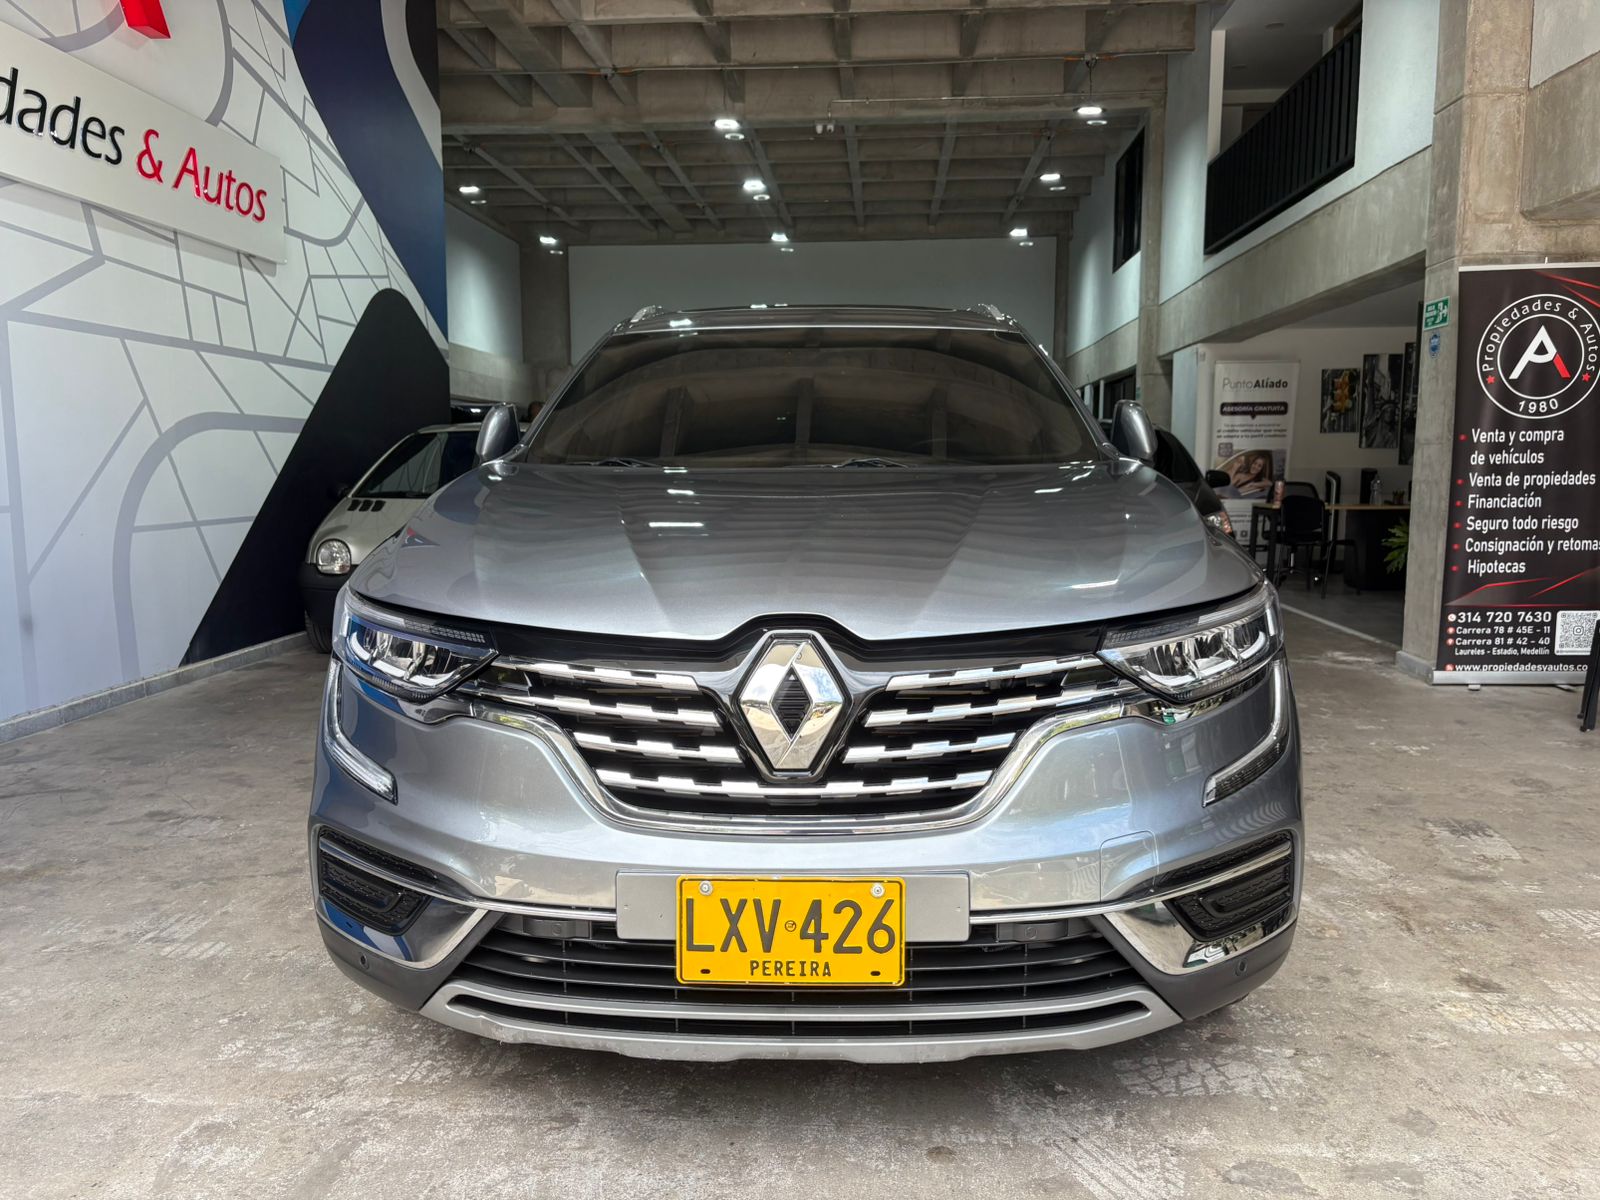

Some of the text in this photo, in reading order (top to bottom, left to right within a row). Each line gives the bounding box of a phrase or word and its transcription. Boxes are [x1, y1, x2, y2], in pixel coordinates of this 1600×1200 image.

[136, 128, 163, 183] &
[172, 147, 268, 222] Autos
[1482, 299, 1599, 372] Propiedades & Autos
[1518, 398, 1559, 414] 1980
[1472, 428, 1564, 446] Venta y compra
[1470, 448, 1544, 465] de vehículos
[1469, 470, 1596, 489] Venta de propiedades
[1467, 492, 1541, 508] Financiación
[1466, 515, 1579, 533] Seguro todo riesgo
[1465, 536, 1600, 555] Consignación y retoma
[1467, 559, 1526, 577] Hipotecas
[1457, 611, 1552, 623] 314 720 7630
[1456, 626, 1491, 634] Carrera
[1494, 626, 1504, 634] 78
[1507, 626, 1513, 634] #
[1516, 626, 1534, 634] 45E
[1543, 626, 1550, 634] 11
[1455, 638, 1492, 646] Carrera
[1494, 637, 1504, 645] 81
[1516, 637, 1528, 645] 42
[1538, 637, 1550, 645] 40
[1455, 648, 1485, 656] Laureles
[1492, 648, 1519, 656] Estadio,
[1520, 647, 1550, 655] Medellín
[686, 898, 896, 954] LXV 426
[749, 959, 832, 977] PEREIRA
